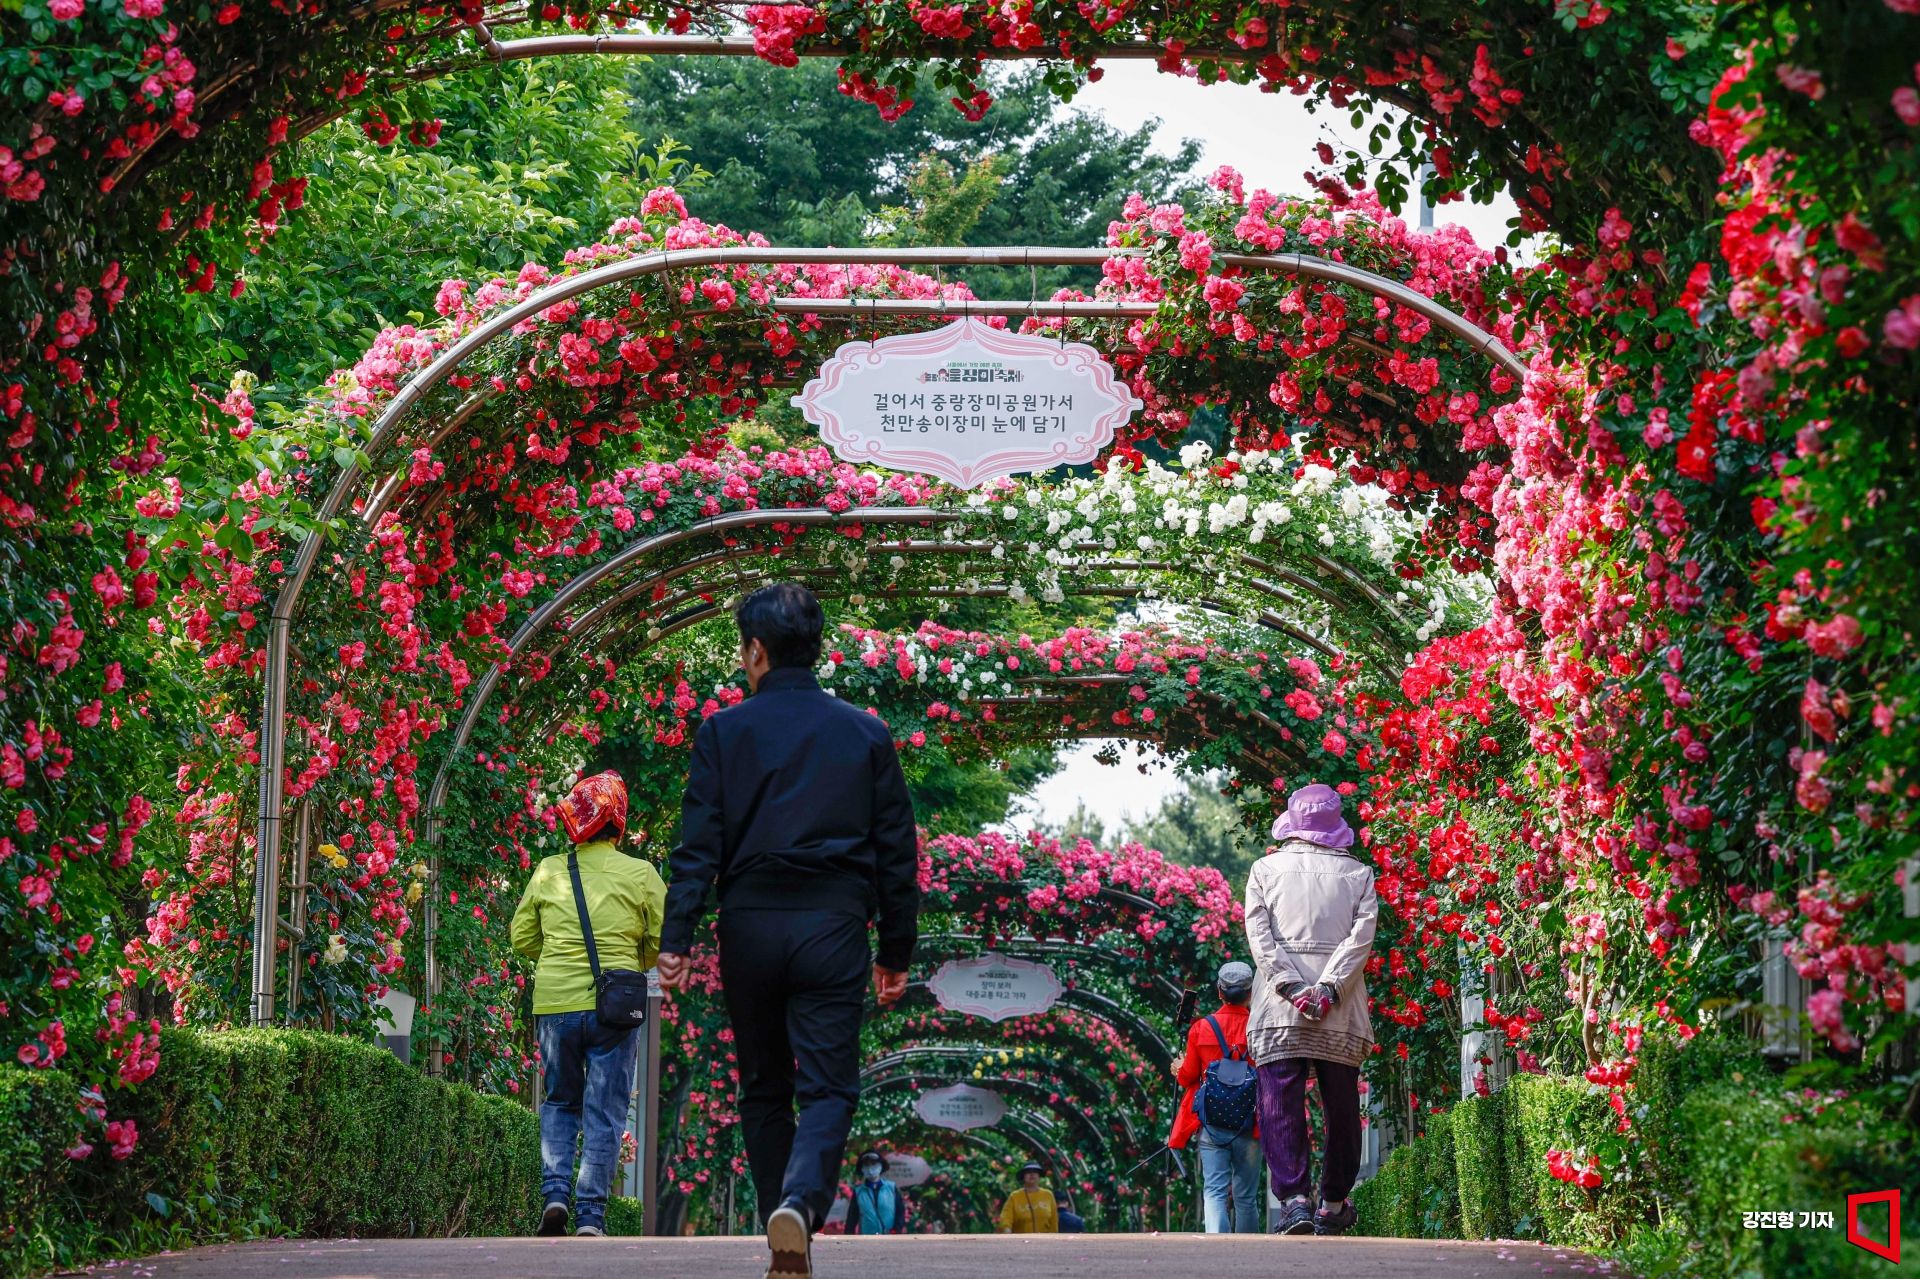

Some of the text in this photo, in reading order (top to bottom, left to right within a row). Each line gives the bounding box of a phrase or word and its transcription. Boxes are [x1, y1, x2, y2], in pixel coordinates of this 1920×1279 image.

[873, 392, 1074, 413] 걸어서 중랑장미공원가서
[880, 414, 1067, 433] 천만송이장미 눈에 담기
